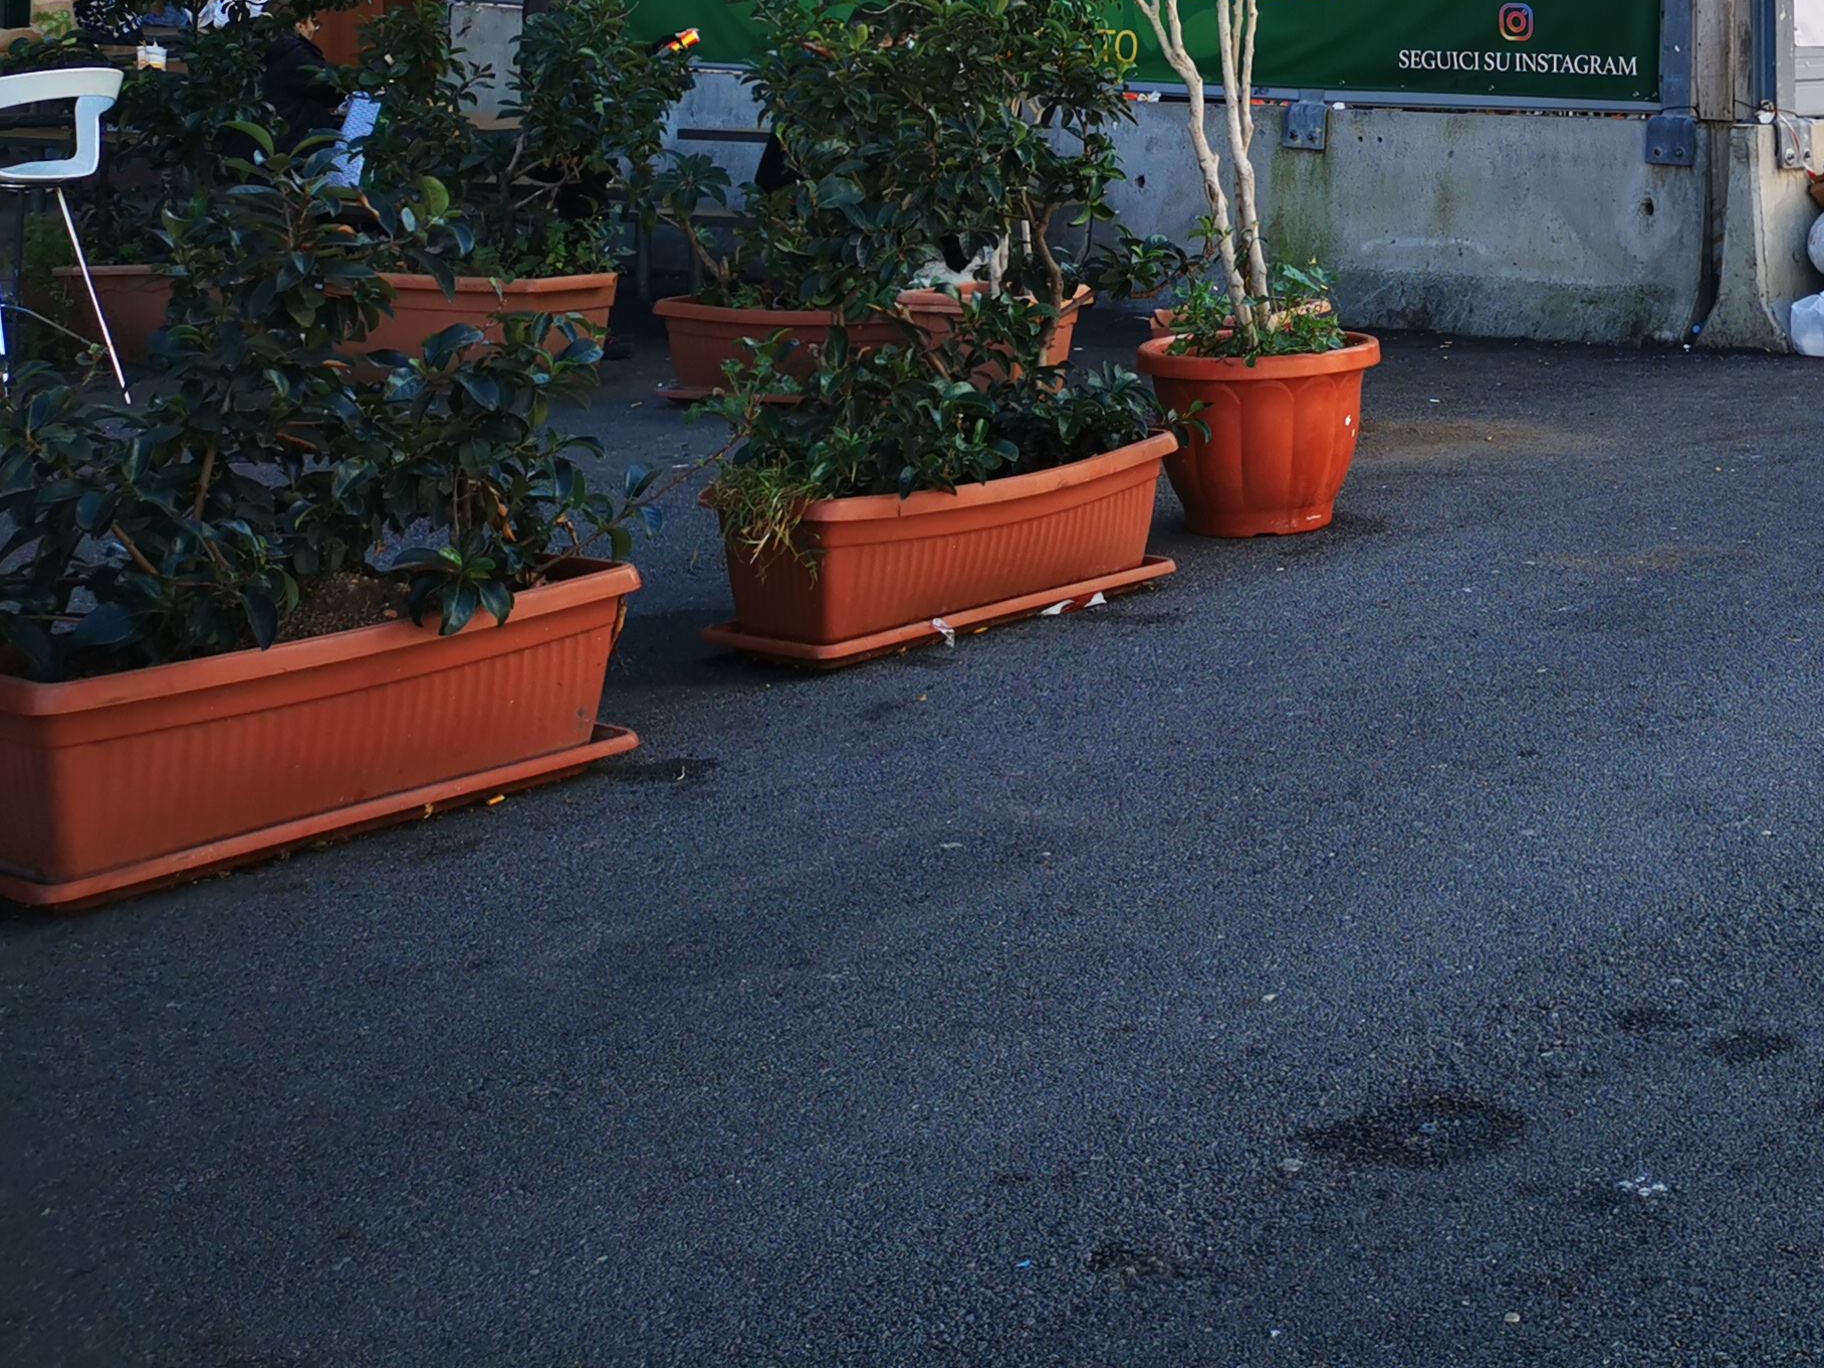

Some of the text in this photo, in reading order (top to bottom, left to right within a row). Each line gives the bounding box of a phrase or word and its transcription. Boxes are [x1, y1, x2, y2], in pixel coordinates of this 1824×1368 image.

[1398, 49, 1638, 76] SEGUICI SU INSTAGRAM
